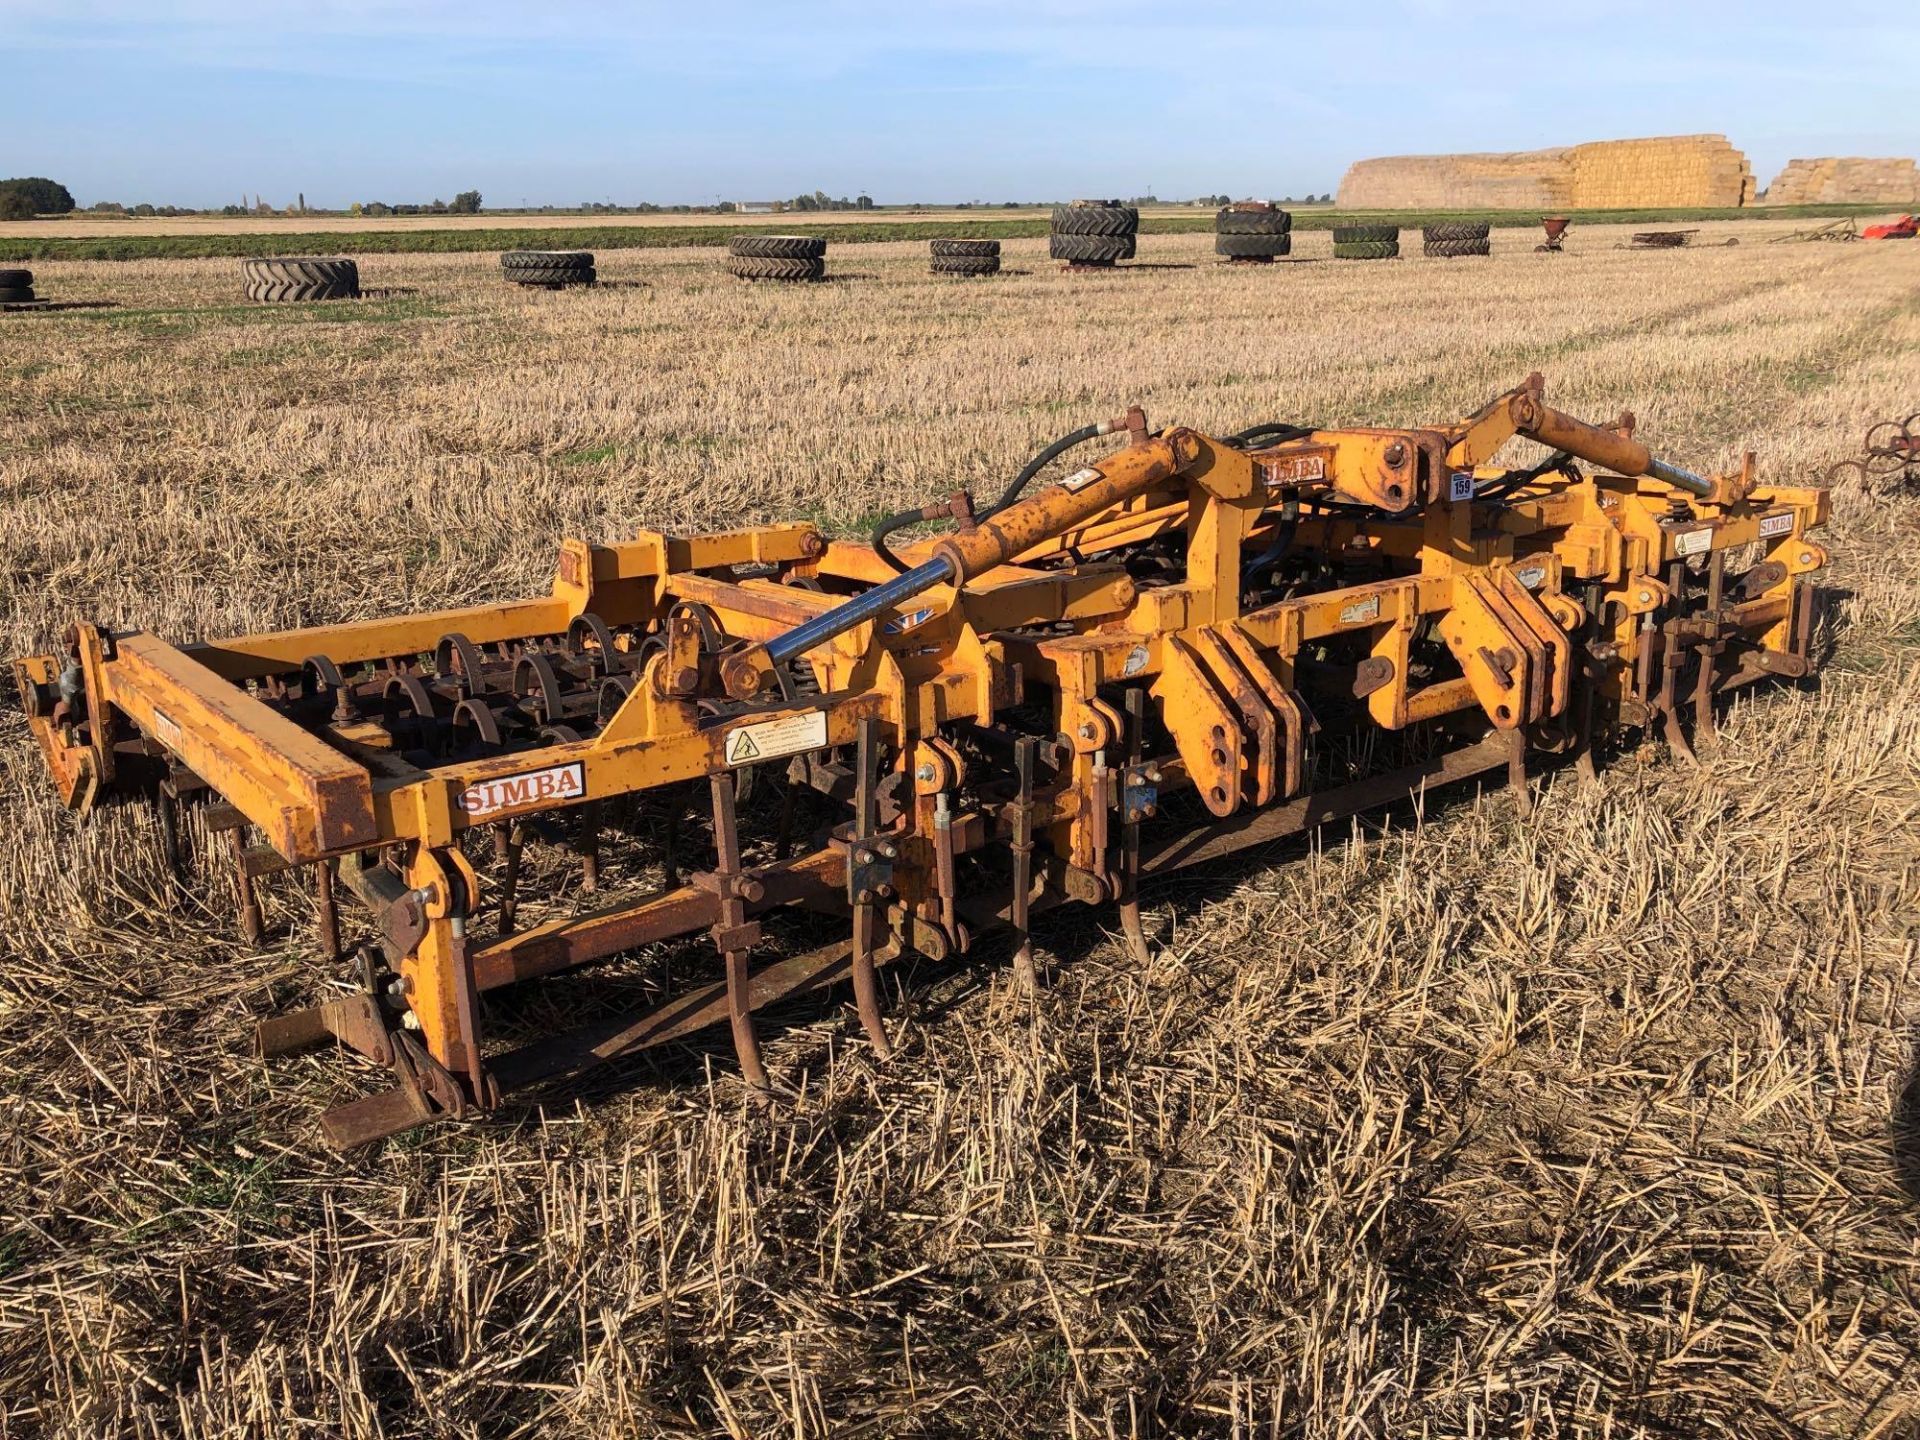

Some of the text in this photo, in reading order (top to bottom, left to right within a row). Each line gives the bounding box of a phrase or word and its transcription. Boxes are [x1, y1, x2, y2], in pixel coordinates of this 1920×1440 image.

[1263, 459, 1321, 482] SIMBA
[1455, 480, 1470, 494] 159
[1760, 516, 1792, 534] SIMBA
[463, 769, 579, 812] SIMBA
